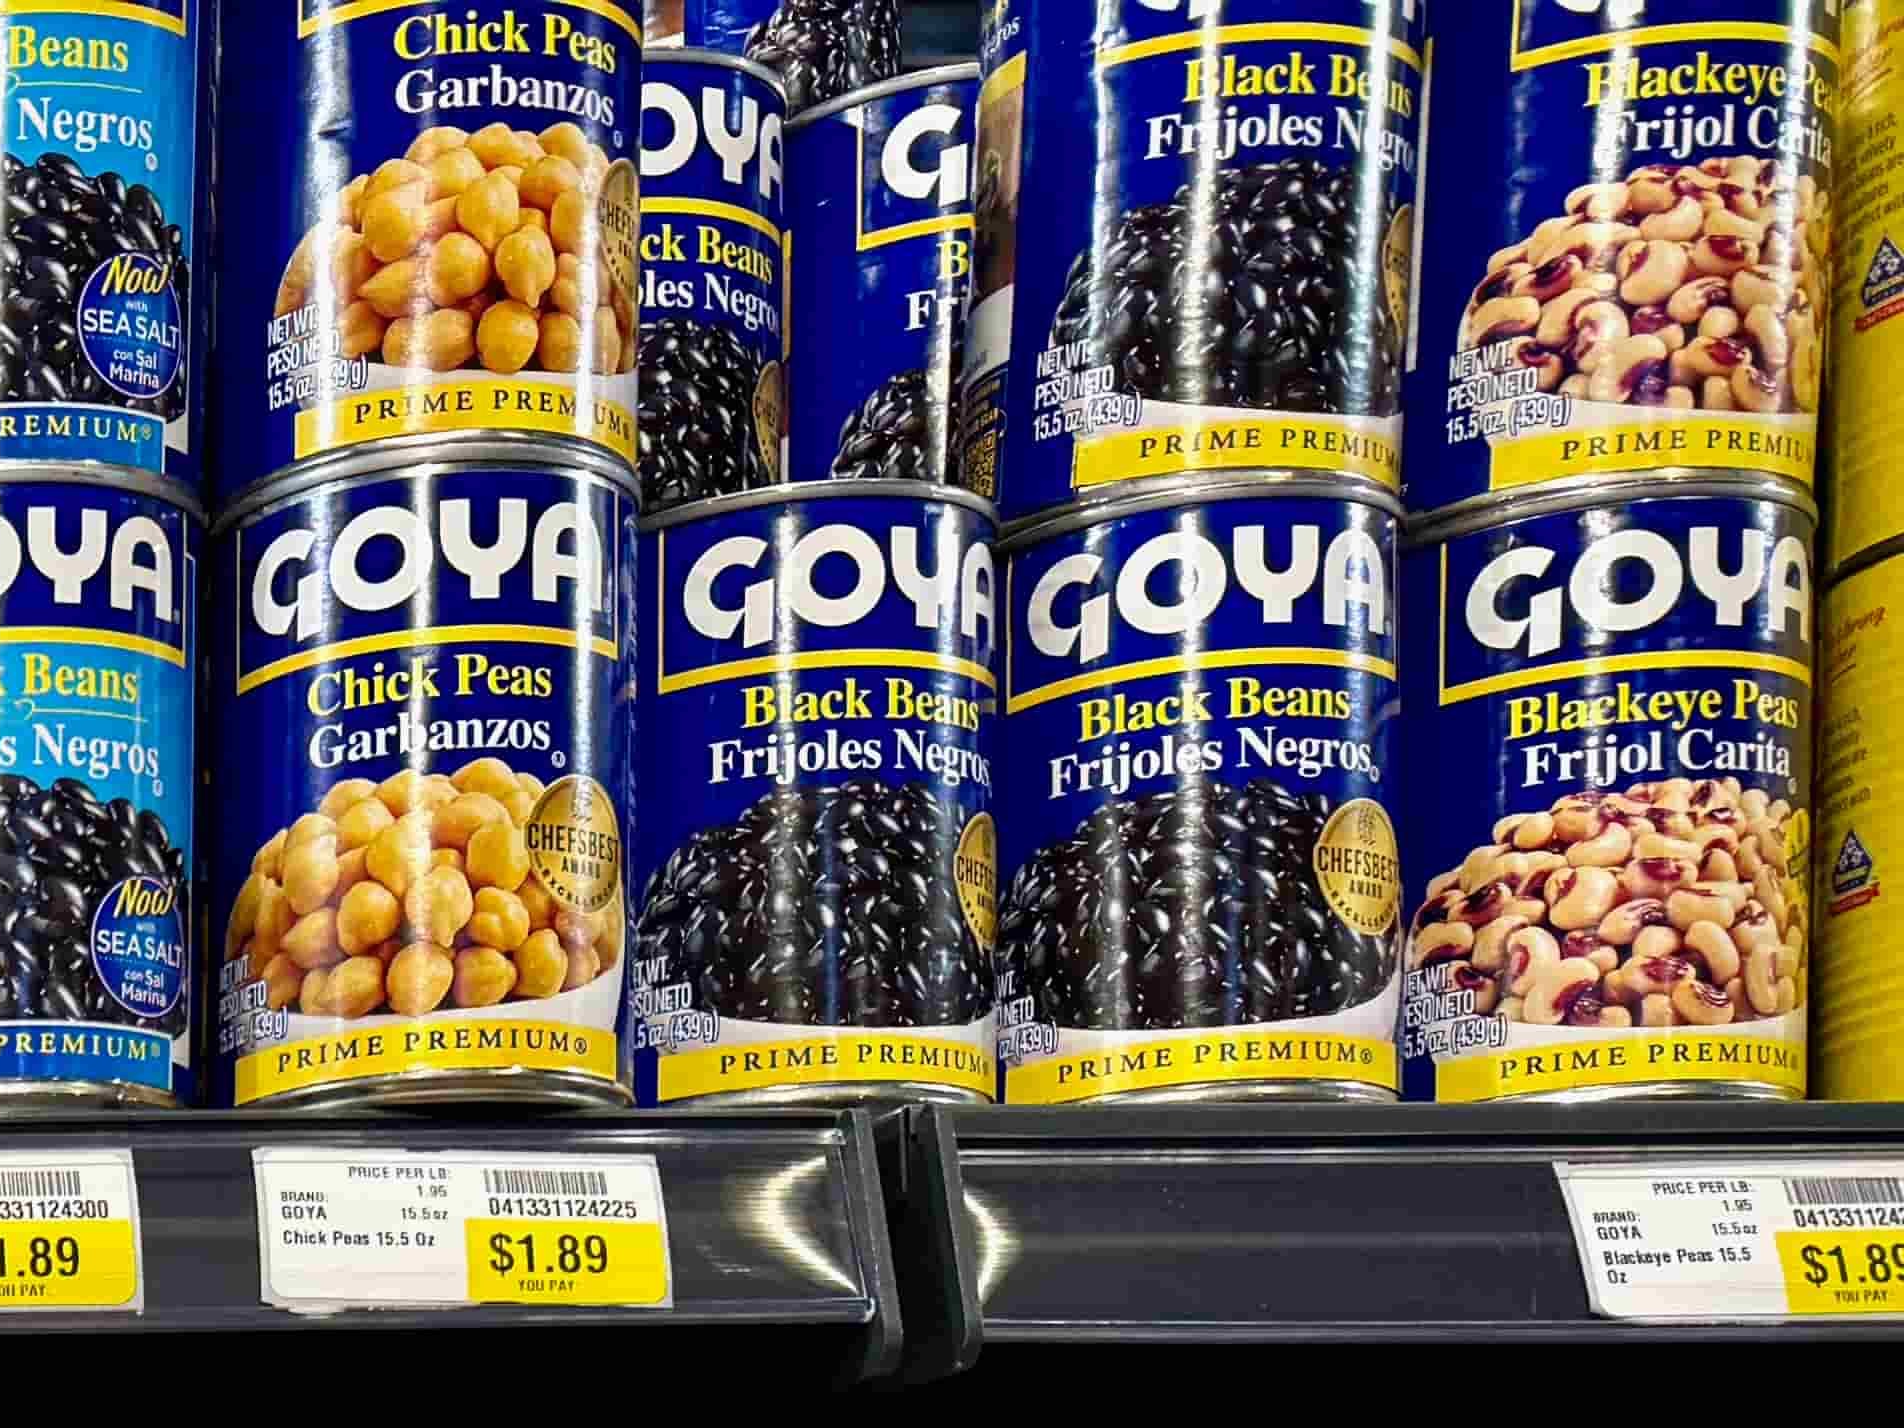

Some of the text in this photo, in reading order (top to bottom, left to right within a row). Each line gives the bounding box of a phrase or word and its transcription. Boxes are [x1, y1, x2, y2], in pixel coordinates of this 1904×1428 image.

[8, 30, 129, 77] Beans
[393, 11, 617, 74] Chick Peas
[395, 60, 615, 129] Garbanzos
[18, 96, 155, 152] Negros
[81, 309, 180, 348] SEA SALT
[1048, 729, 1372, 801] Frijoles Negros
[1520, 727, 1791, 790] Frijol Carita
[488, 1198, 638, 1219] 041331124225
[283, 1230, 327, 1246] Chick
[332, 1232, 371, 1247] Peas
[375, 1232, 410, 1247] 15.5
[489, 1232, 608, 1276] $1.89
[1604, 1248, 1752, 1266] Blackeye Peas 15.5
